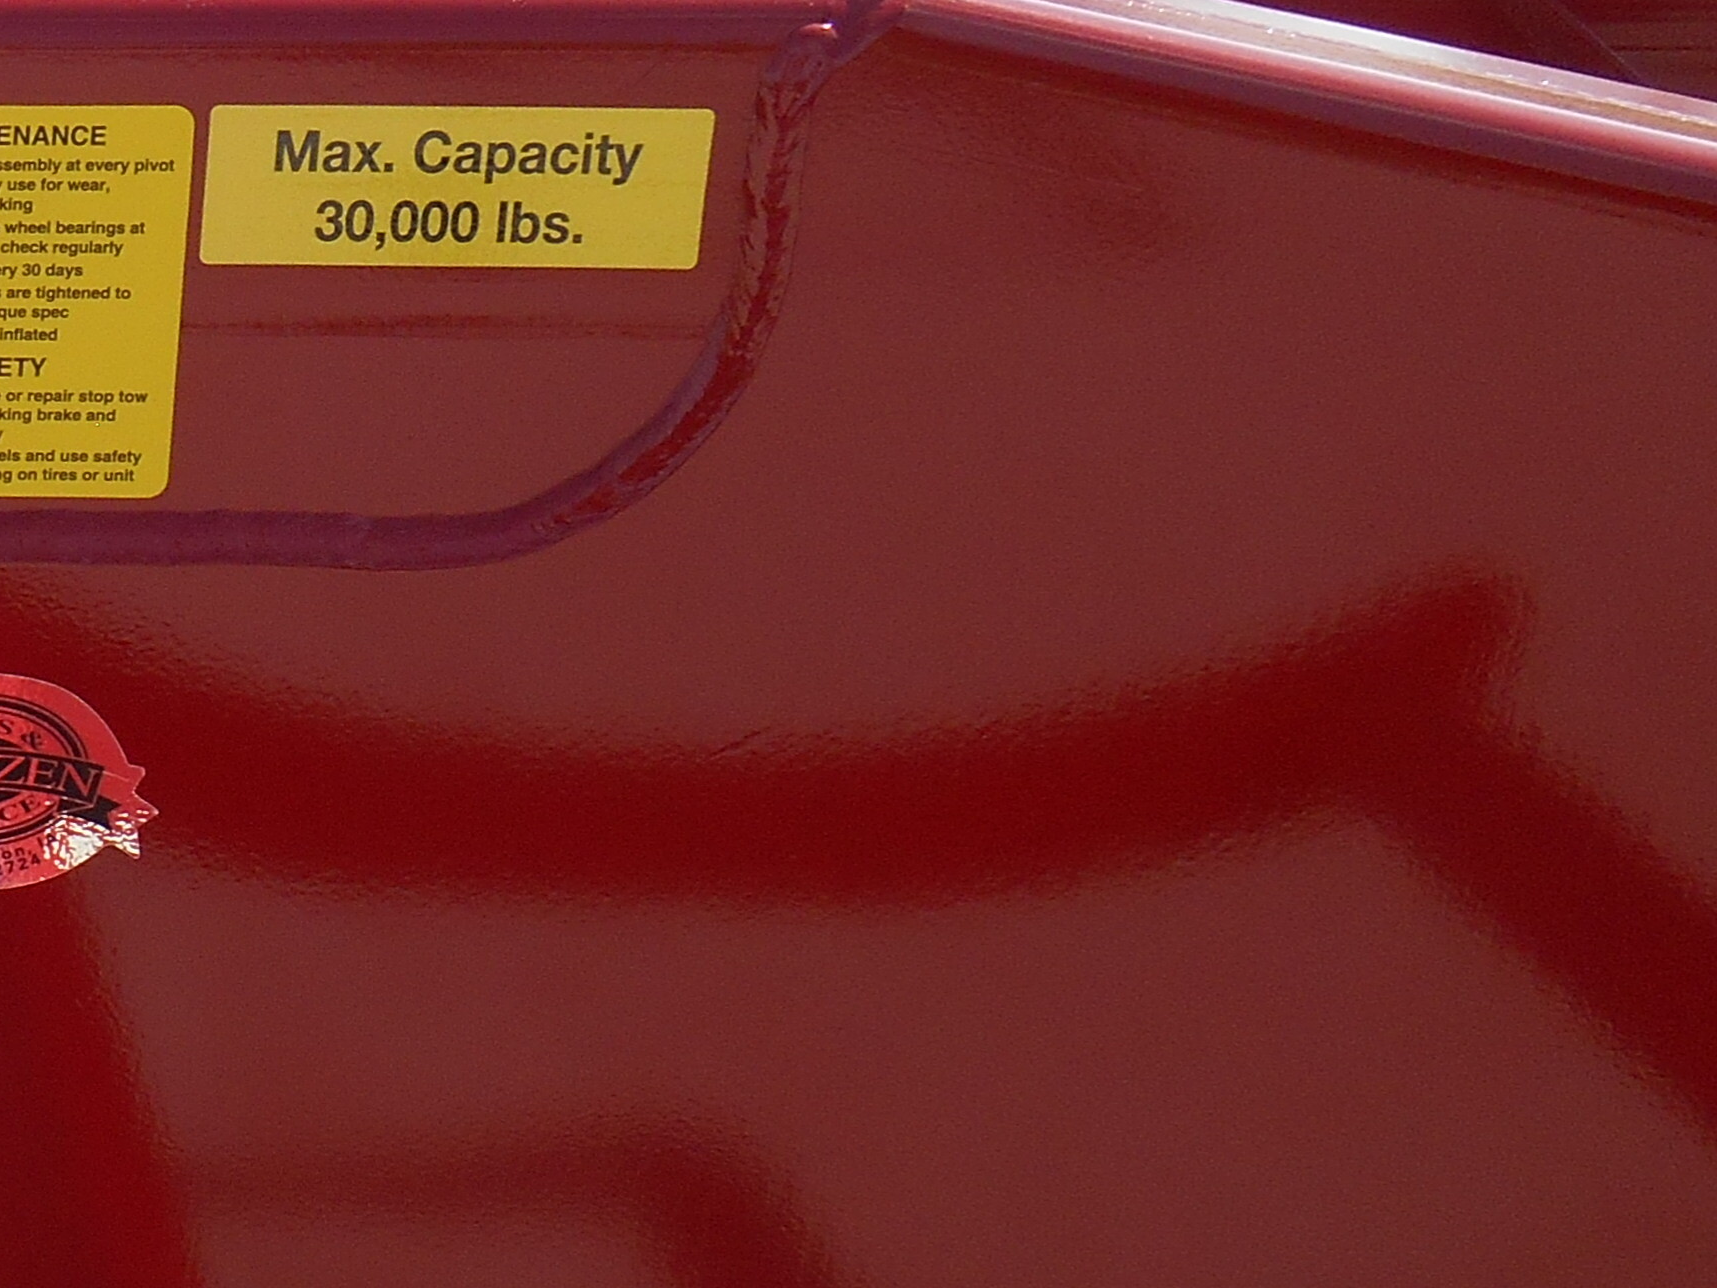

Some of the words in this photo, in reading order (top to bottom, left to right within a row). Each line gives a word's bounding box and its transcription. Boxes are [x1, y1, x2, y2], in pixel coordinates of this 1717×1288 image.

[272, 130, 395, 174] Max.
[414, 130, 644, 186] Capacity
[65, 159, 81, 170] at
[85, 161, 130, 173] every
[133, 160, 175, 173] pivot
[6, 181, 37, 190] use
[40, 179, 64, 190] for
[67, 181, 110, 193] wear,
[3, 222, 51, 233] wheel
[55, 222, 125, 236] bearings
[129, 223, 145, 234] at
[314, 200, 479, 252] 30,000
[496, 201, 583, 245] lbs.
[0, 241, 49, 253] check
[51, 242, 124, 256] regularly
[21, 264, 41, 275] 30
[44, 264, 83, 278] days
[24, 450, 56, 461] and
[59, 452, 89, 461] use
[92, 450, 142, 464] safety
[17, 471, 37, 480] on
[41, 469, 77, 480] tires
[81, 471, 100, 480] or
[103, 469, 134, 481] unit
[20, 732, 44, 750] &
